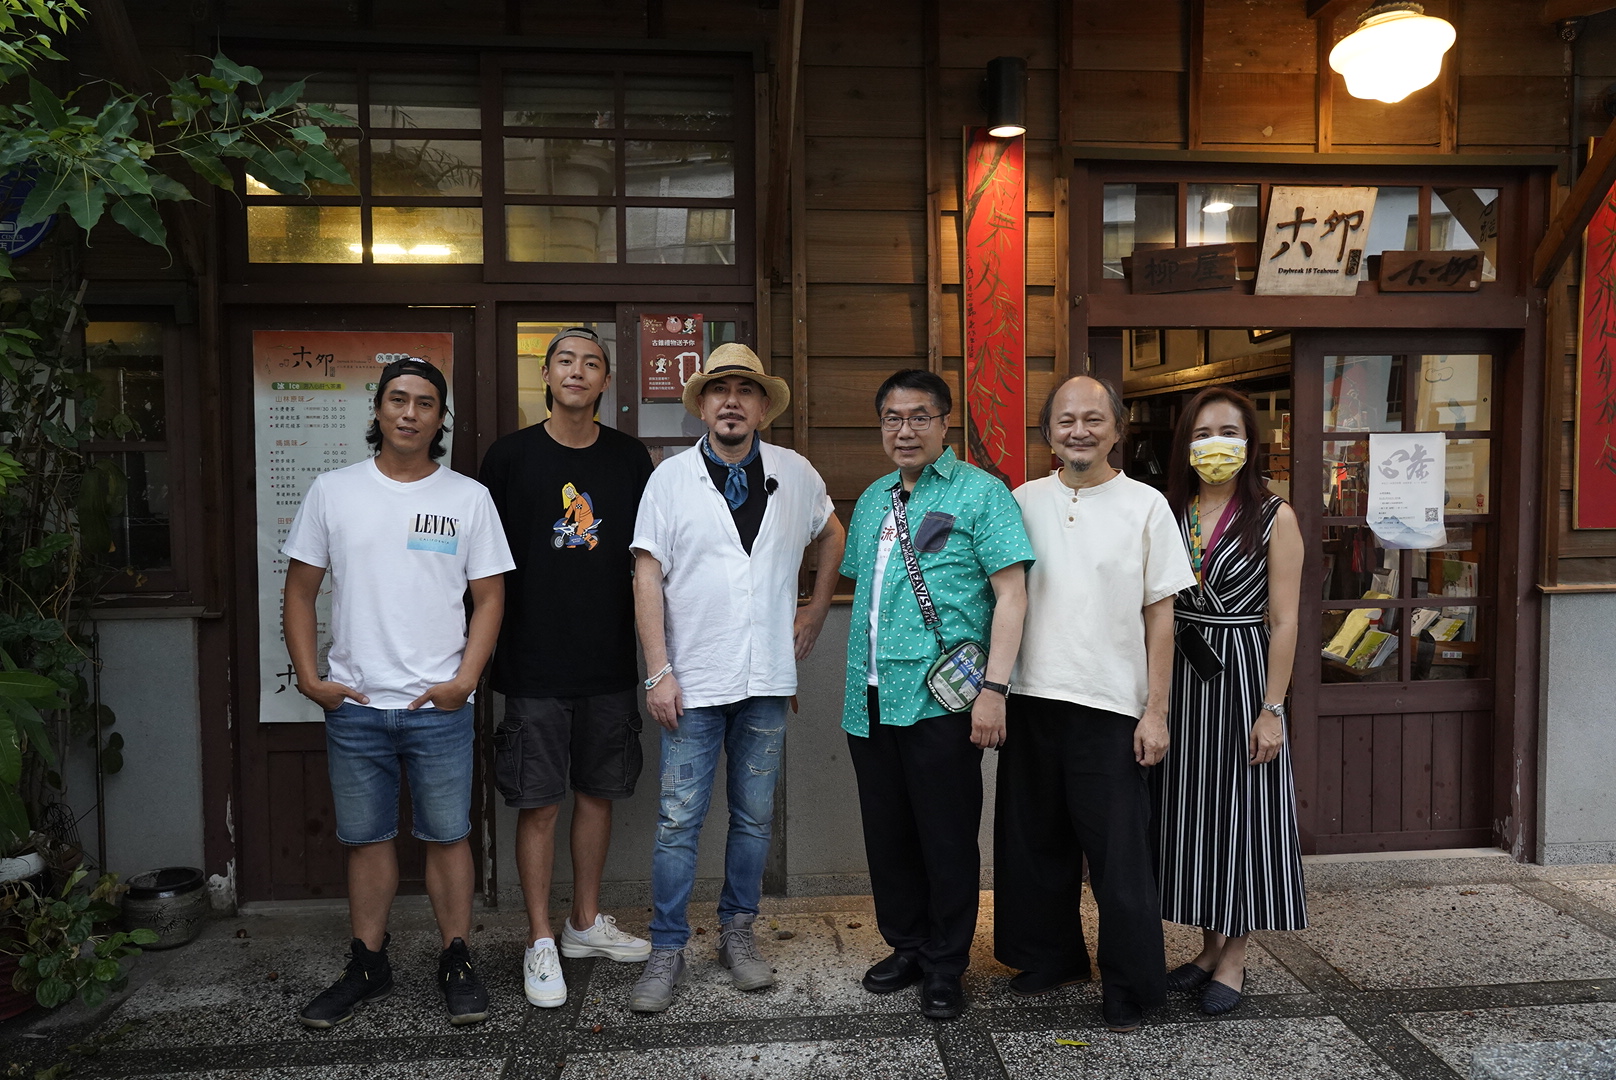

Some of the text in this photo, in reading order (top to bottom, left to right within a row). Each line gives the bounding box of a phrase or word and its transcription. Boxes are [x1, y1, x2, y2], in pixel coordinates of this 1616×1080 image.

[1144, 251, 1225, 286] 柳屋
[1277, 267, 1304, 275] Daybreak
[288, 382, 300, 390] Ice
[275, 395, 305, 403] 山林原味
[414, 513, 457, 538] LEVI'S
